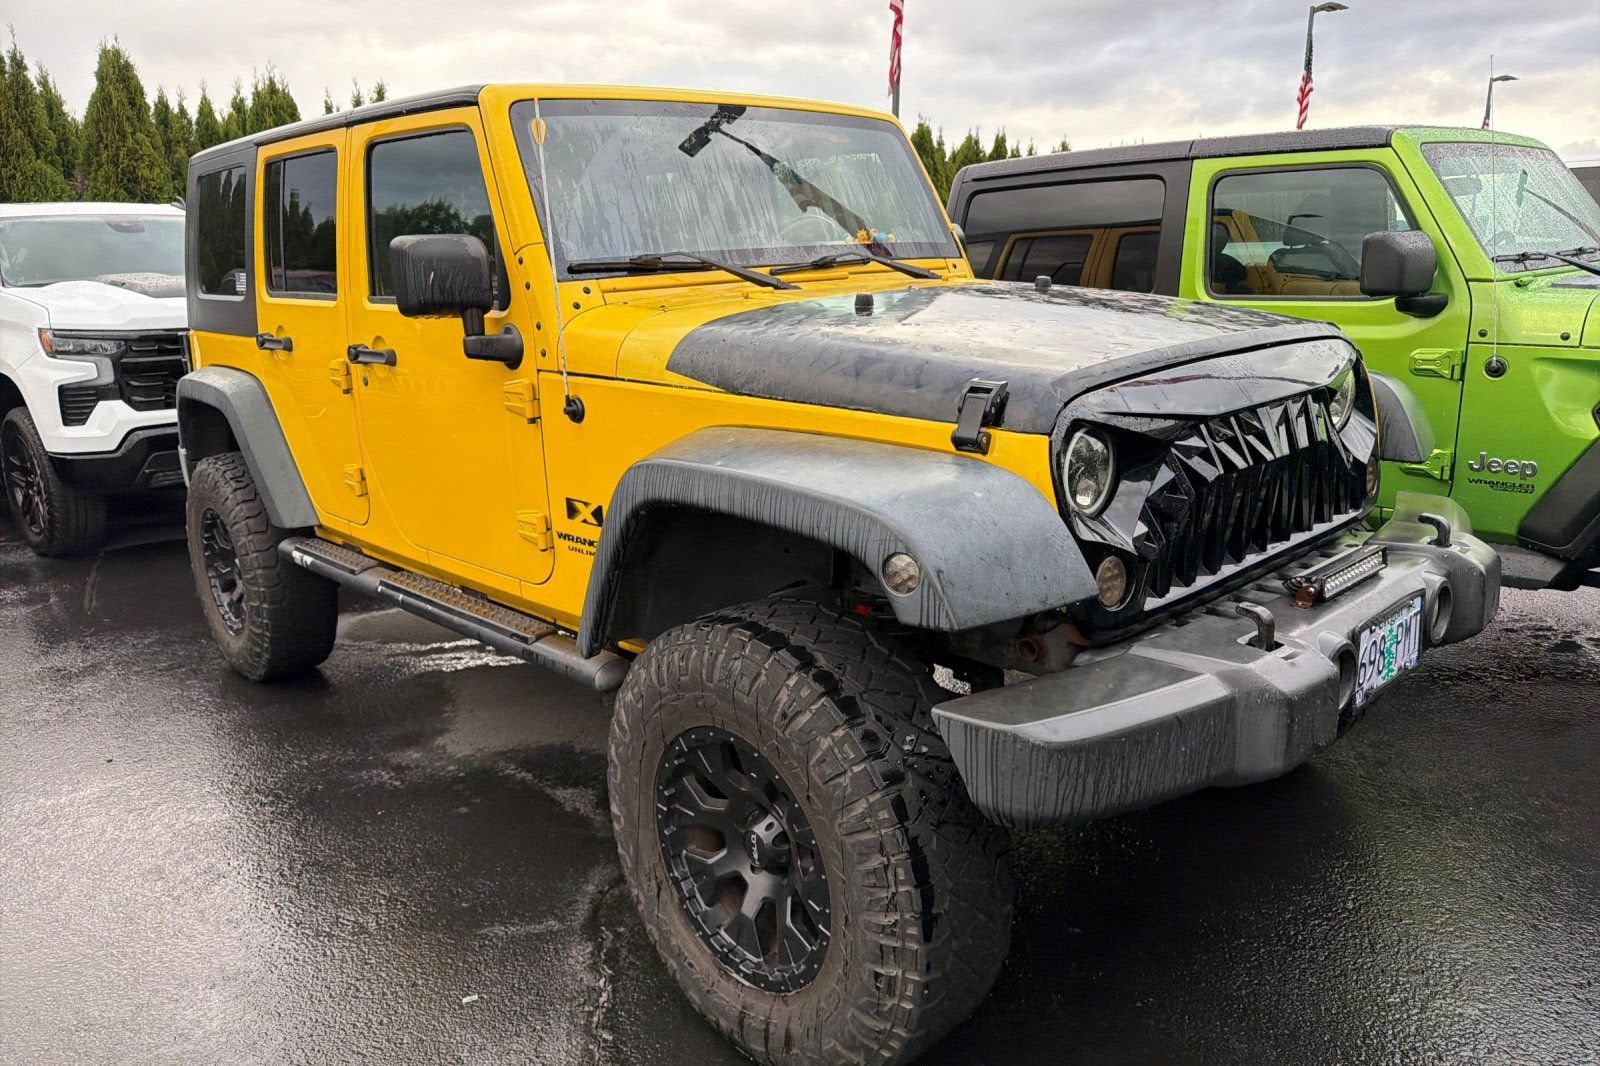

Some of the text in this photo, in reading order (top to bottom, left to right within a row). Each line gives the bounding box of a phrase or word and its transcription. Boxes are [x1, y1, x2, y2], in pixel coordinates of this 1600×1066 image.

[1467, 451, 1538, 480] Jeep
[1467, 477, 1536, 490] WRANGLER
[565, 496, 604, 528] X
[1358, 609, 1421, 688] 698 PMT
